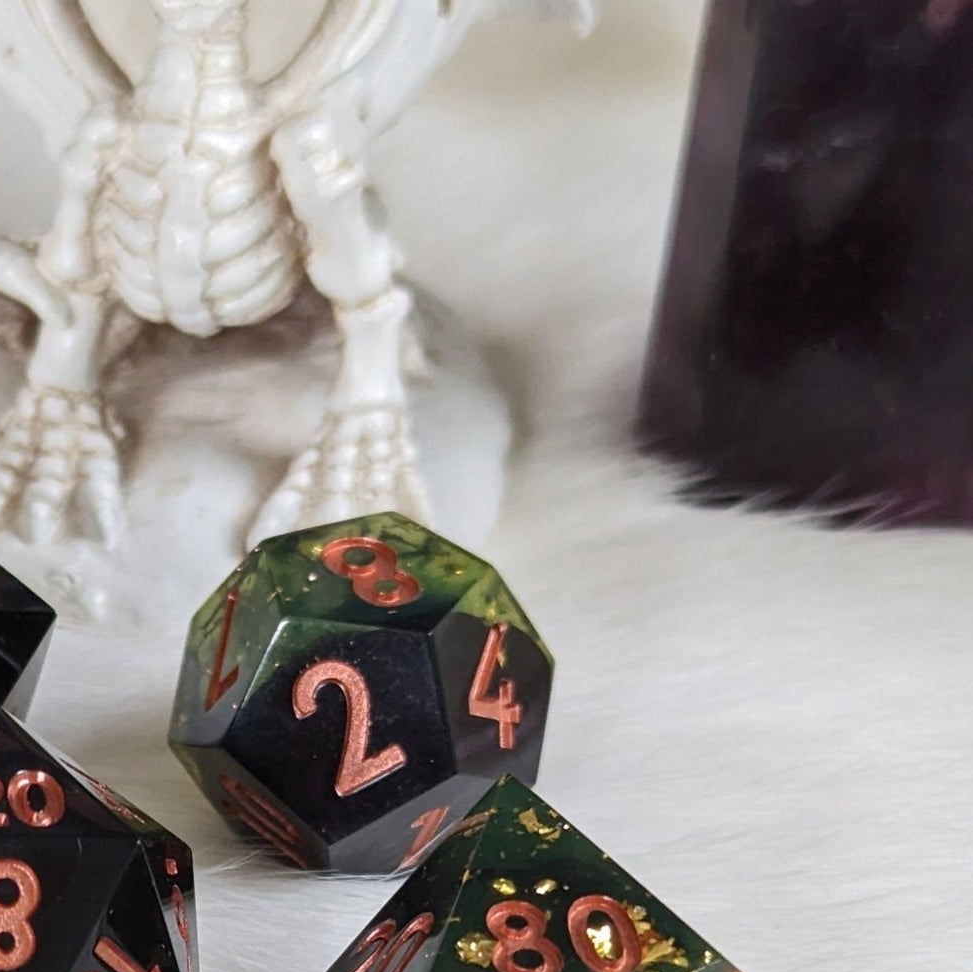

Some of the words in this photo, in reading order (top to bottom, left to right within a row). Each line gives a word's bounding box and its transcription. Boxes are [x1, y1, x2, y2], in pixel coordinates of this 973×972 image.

[320, 536, 421, 607] 8
[292, 659, 407, 798] 2
[468, 623, 521, 750] 4
